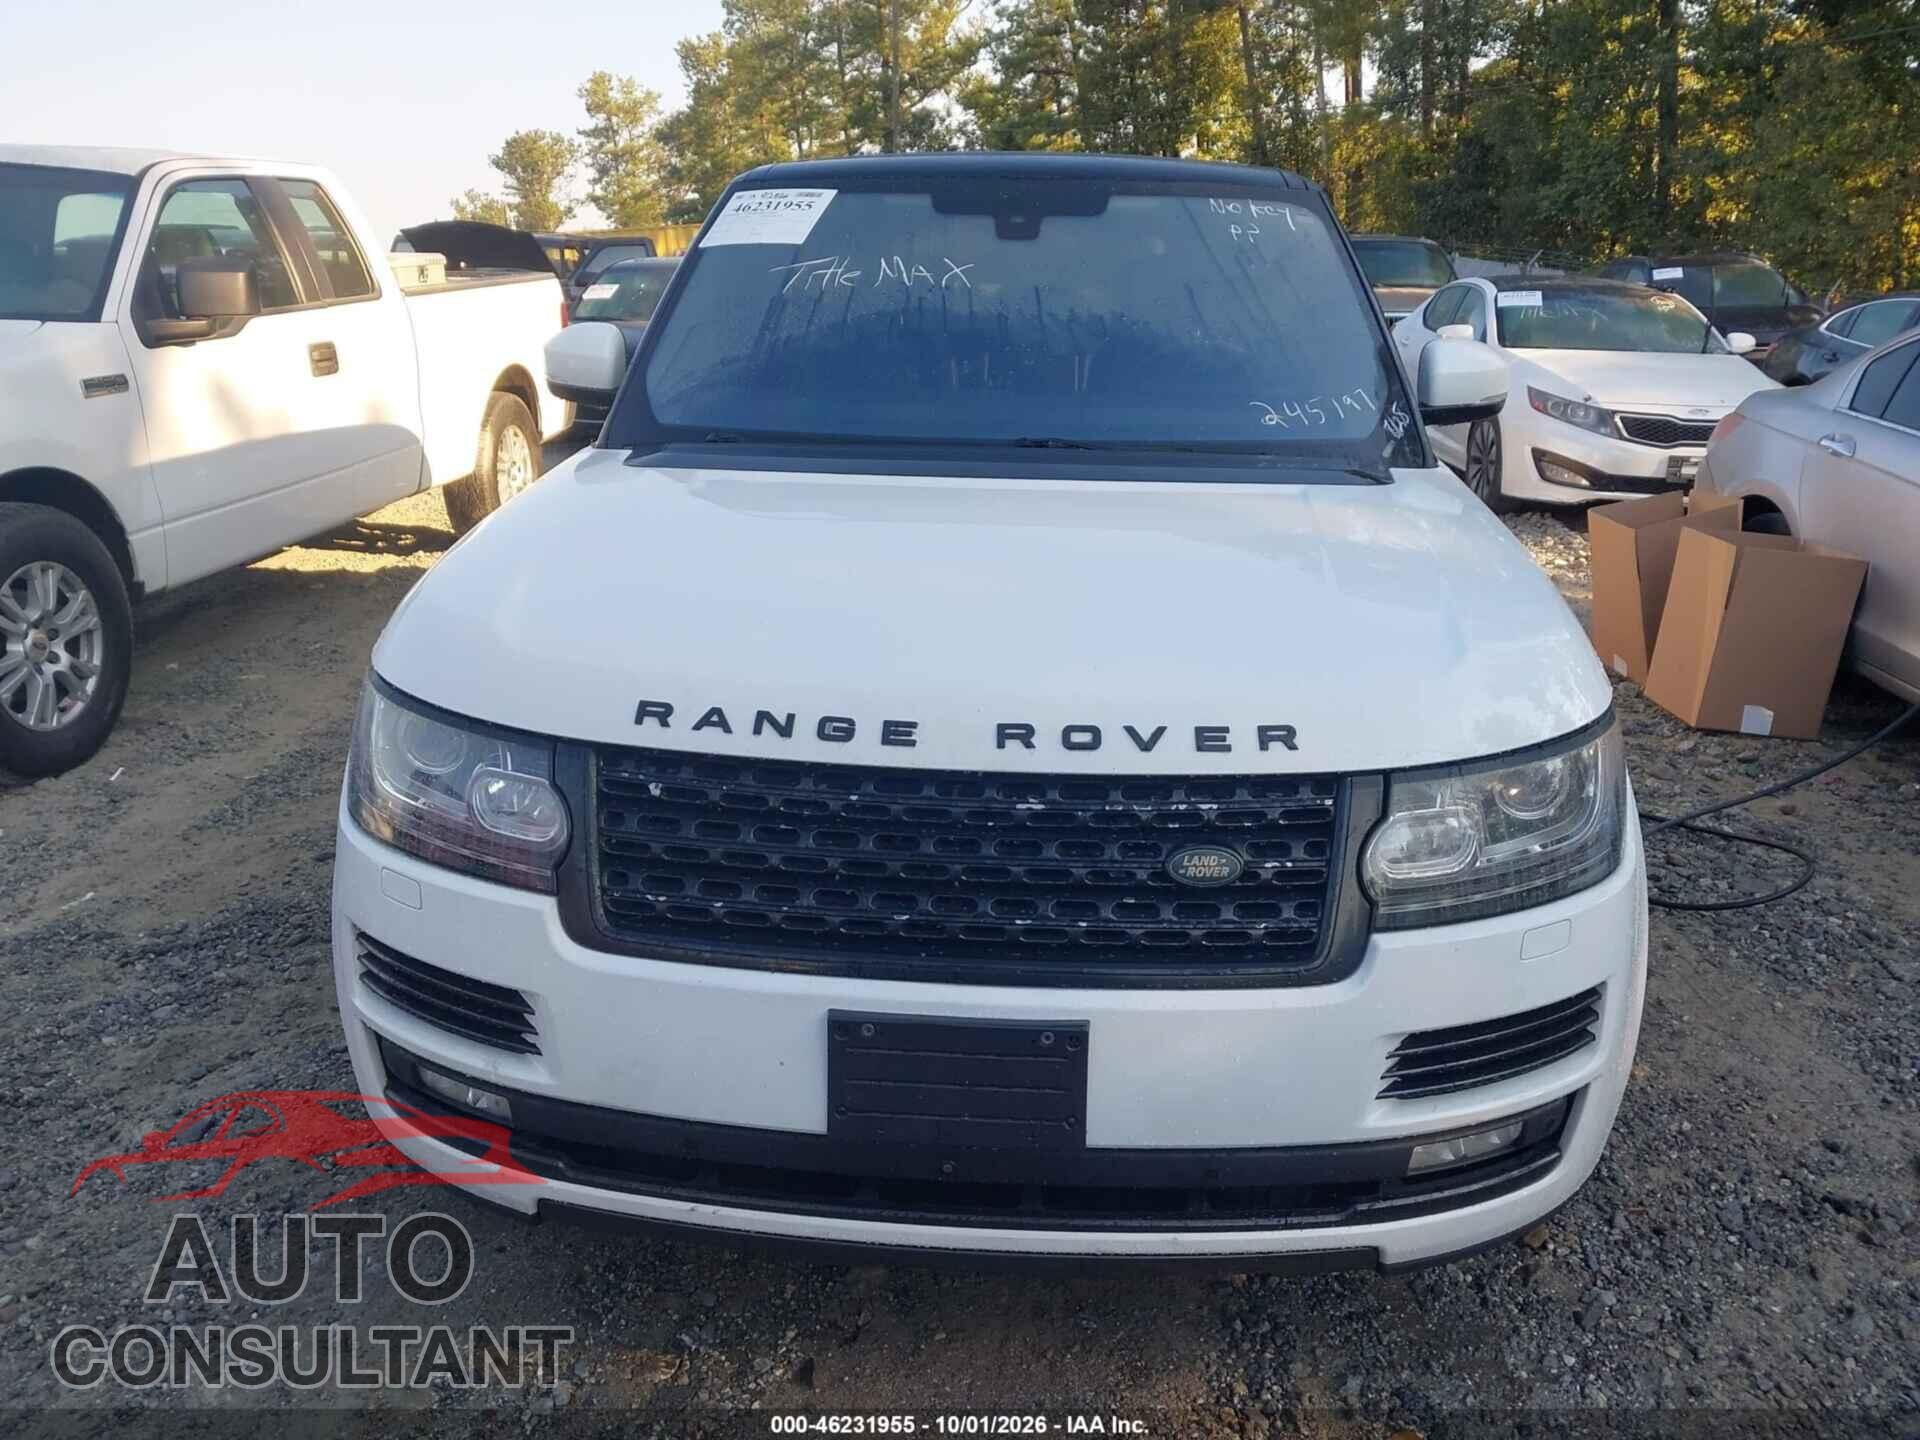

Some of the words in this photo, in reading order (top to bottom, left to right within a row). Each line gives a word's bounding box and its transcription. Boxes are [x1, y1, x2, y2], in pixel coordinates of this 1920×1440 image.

[1209, 198, 1241, 214] No
[1250, 388, 1376, 428] 245197
[634, 700, 918, 748] RANGE
[996, 723, 1299, 753] ROVER
[1183, 855, 1218, 866] LAND
[1186, 866, 1230, 877] ROVER
